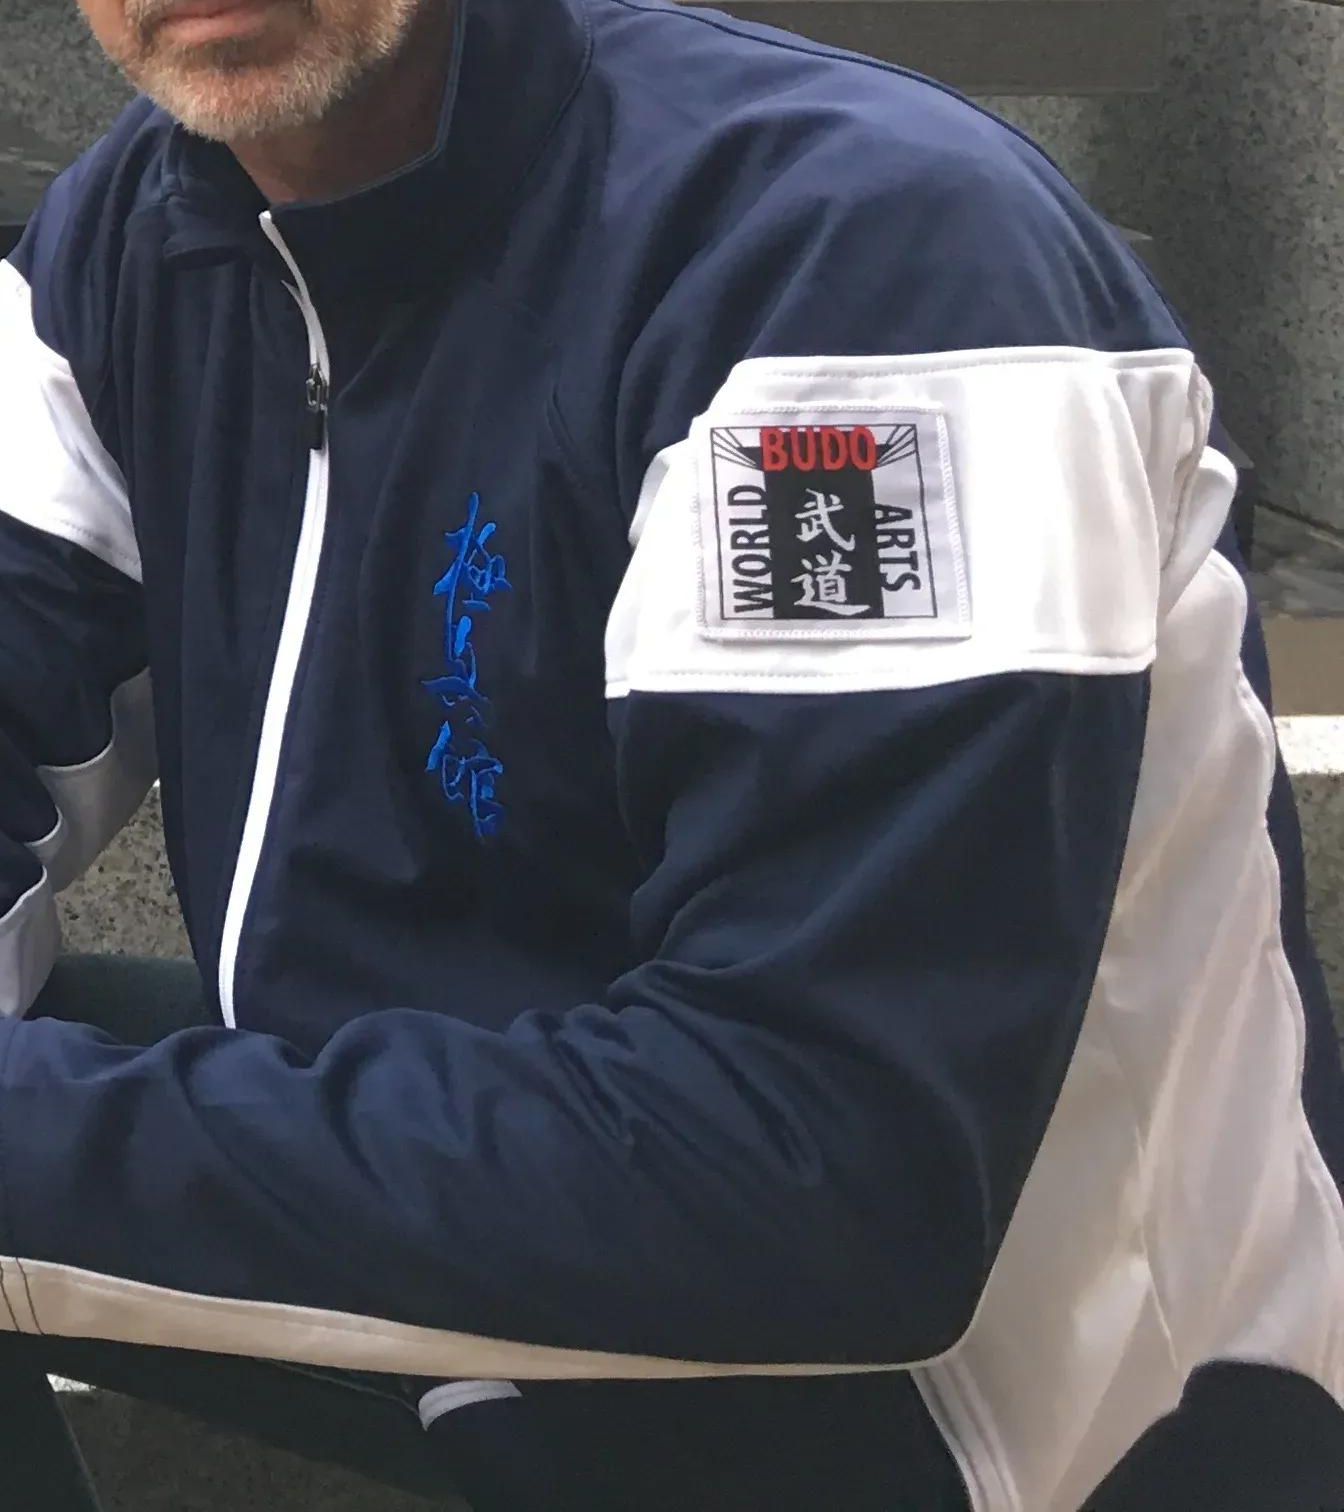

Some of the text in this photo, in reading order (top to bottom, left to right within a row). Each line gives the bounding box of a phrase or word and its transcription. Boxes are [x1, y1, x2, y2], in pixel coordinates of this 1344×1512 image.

[760, 426, 877, 472] BUDO
[727, 484, 774, 615] WORLD
[790, 488, 872, 617] 武道
[872, 501, 923, 593] ARTS
